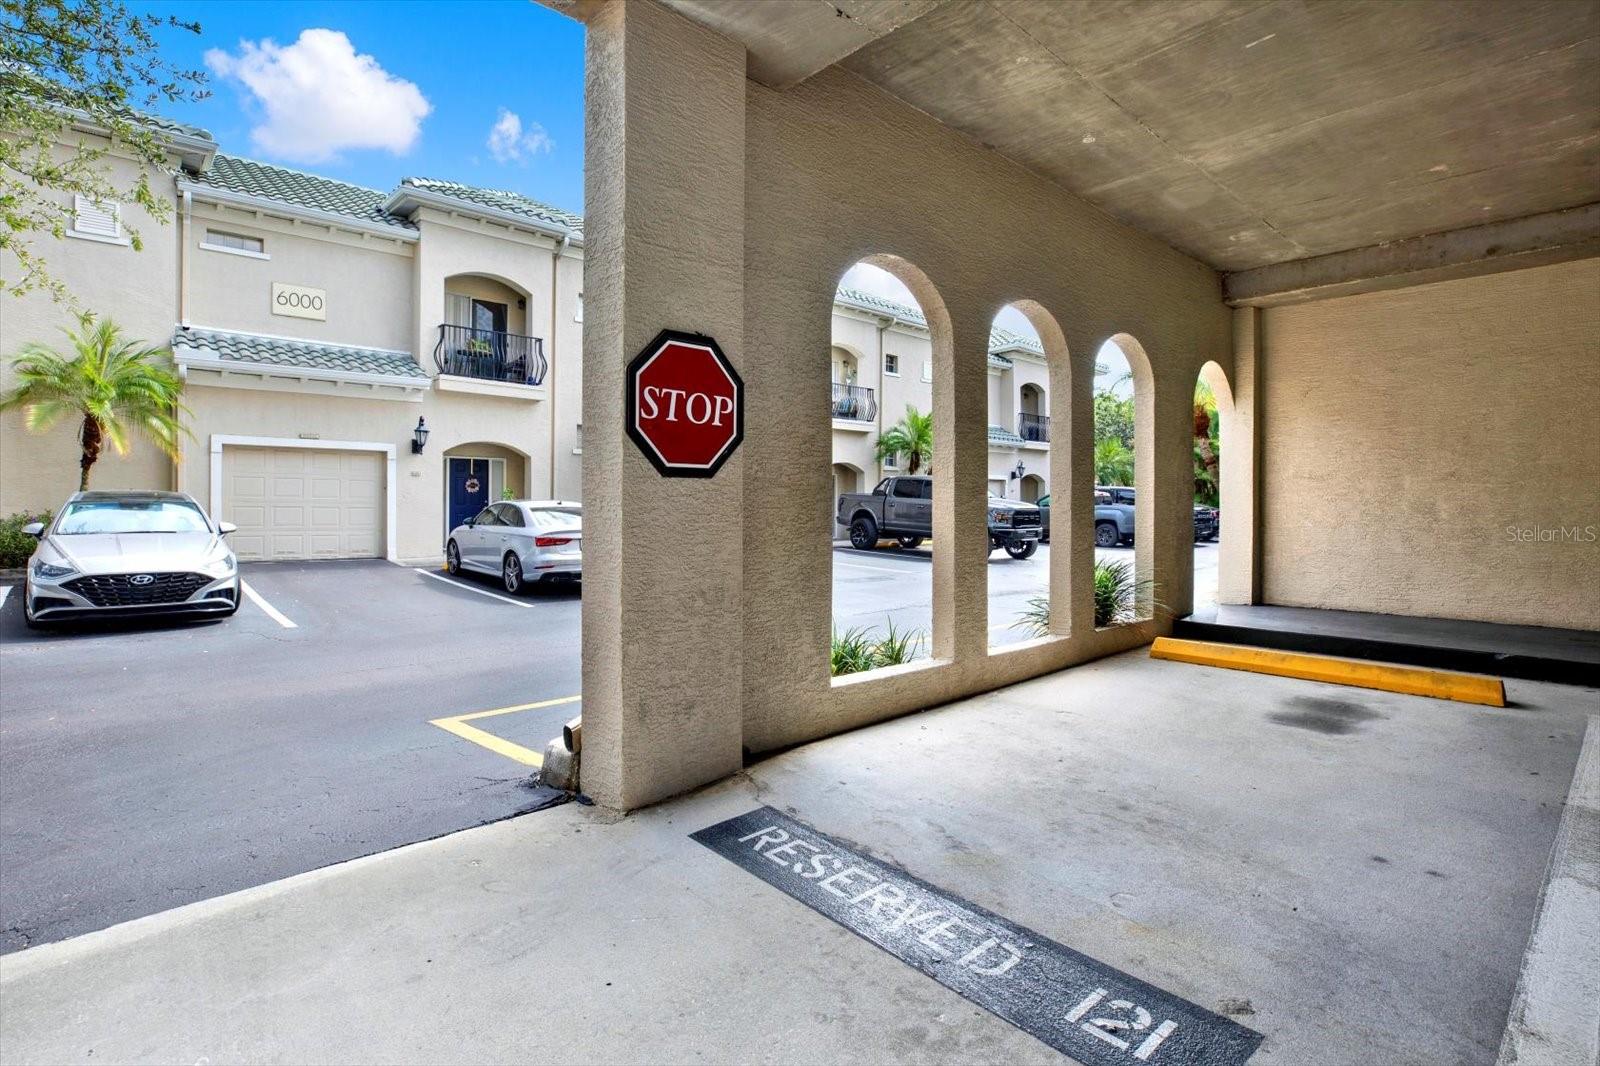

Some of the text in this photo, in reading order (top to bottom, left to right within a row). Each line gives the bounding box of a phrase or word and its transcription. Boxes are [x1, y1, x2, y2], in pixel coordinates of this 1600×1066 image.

[276, 291, 323, 311] 6000
[640, 385, 734, 427] STOP
[738, 825, 1179, 1061] RESERVED 121
